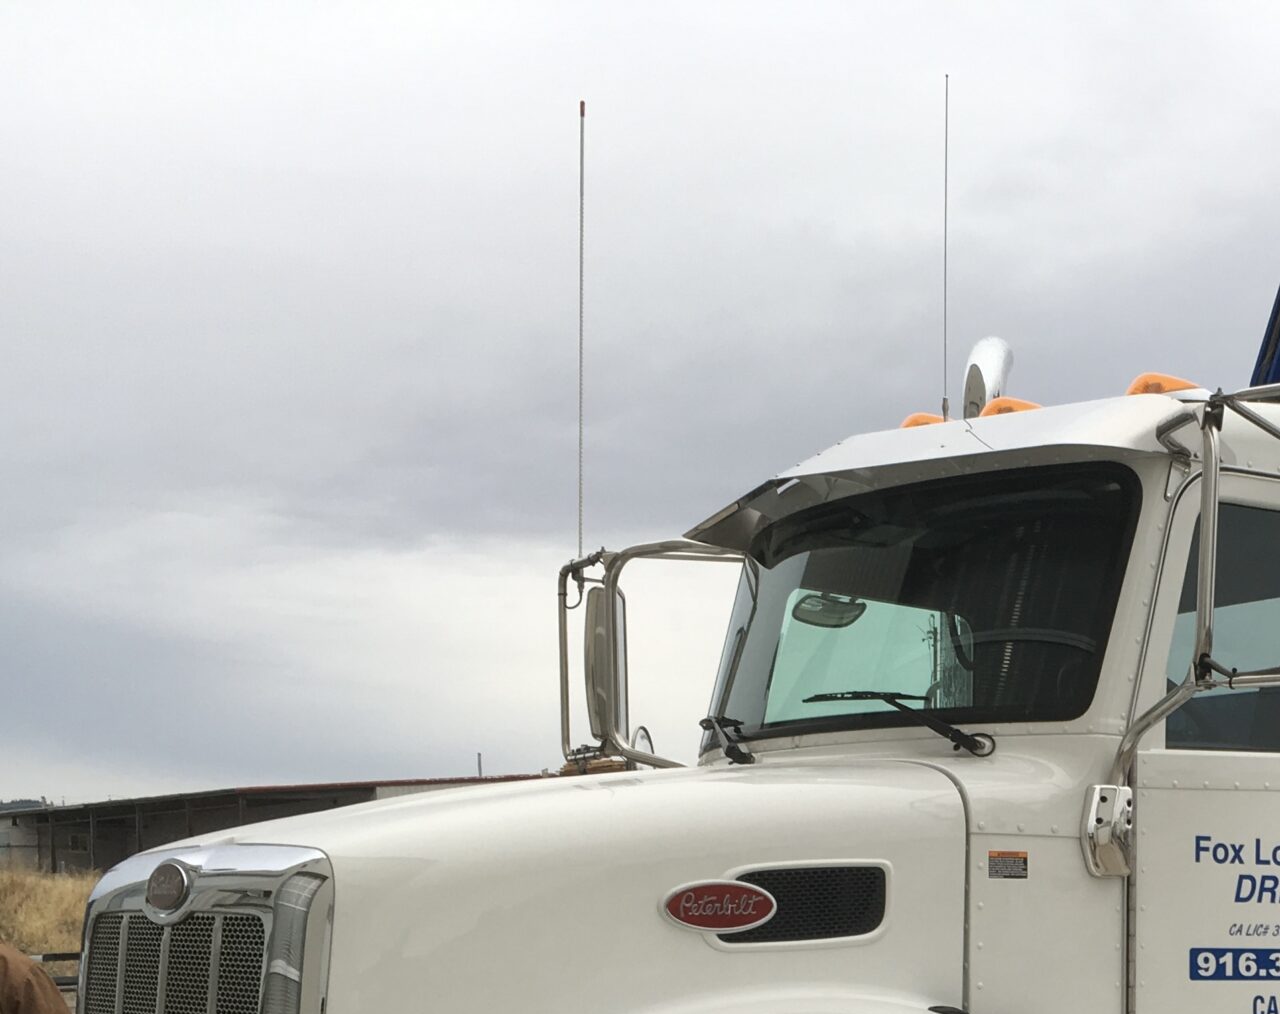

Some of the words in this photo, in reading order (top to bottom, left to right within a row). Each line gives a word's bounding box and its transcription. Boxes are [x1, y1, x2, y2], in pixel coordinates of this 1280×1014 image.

[1194, 835, 1245, 864] Fox
[679, 891, 764, 918] Peterbilt
[1228, 923, 1243, 936] CA
[1245, 924, 1270, 937] LIC#
